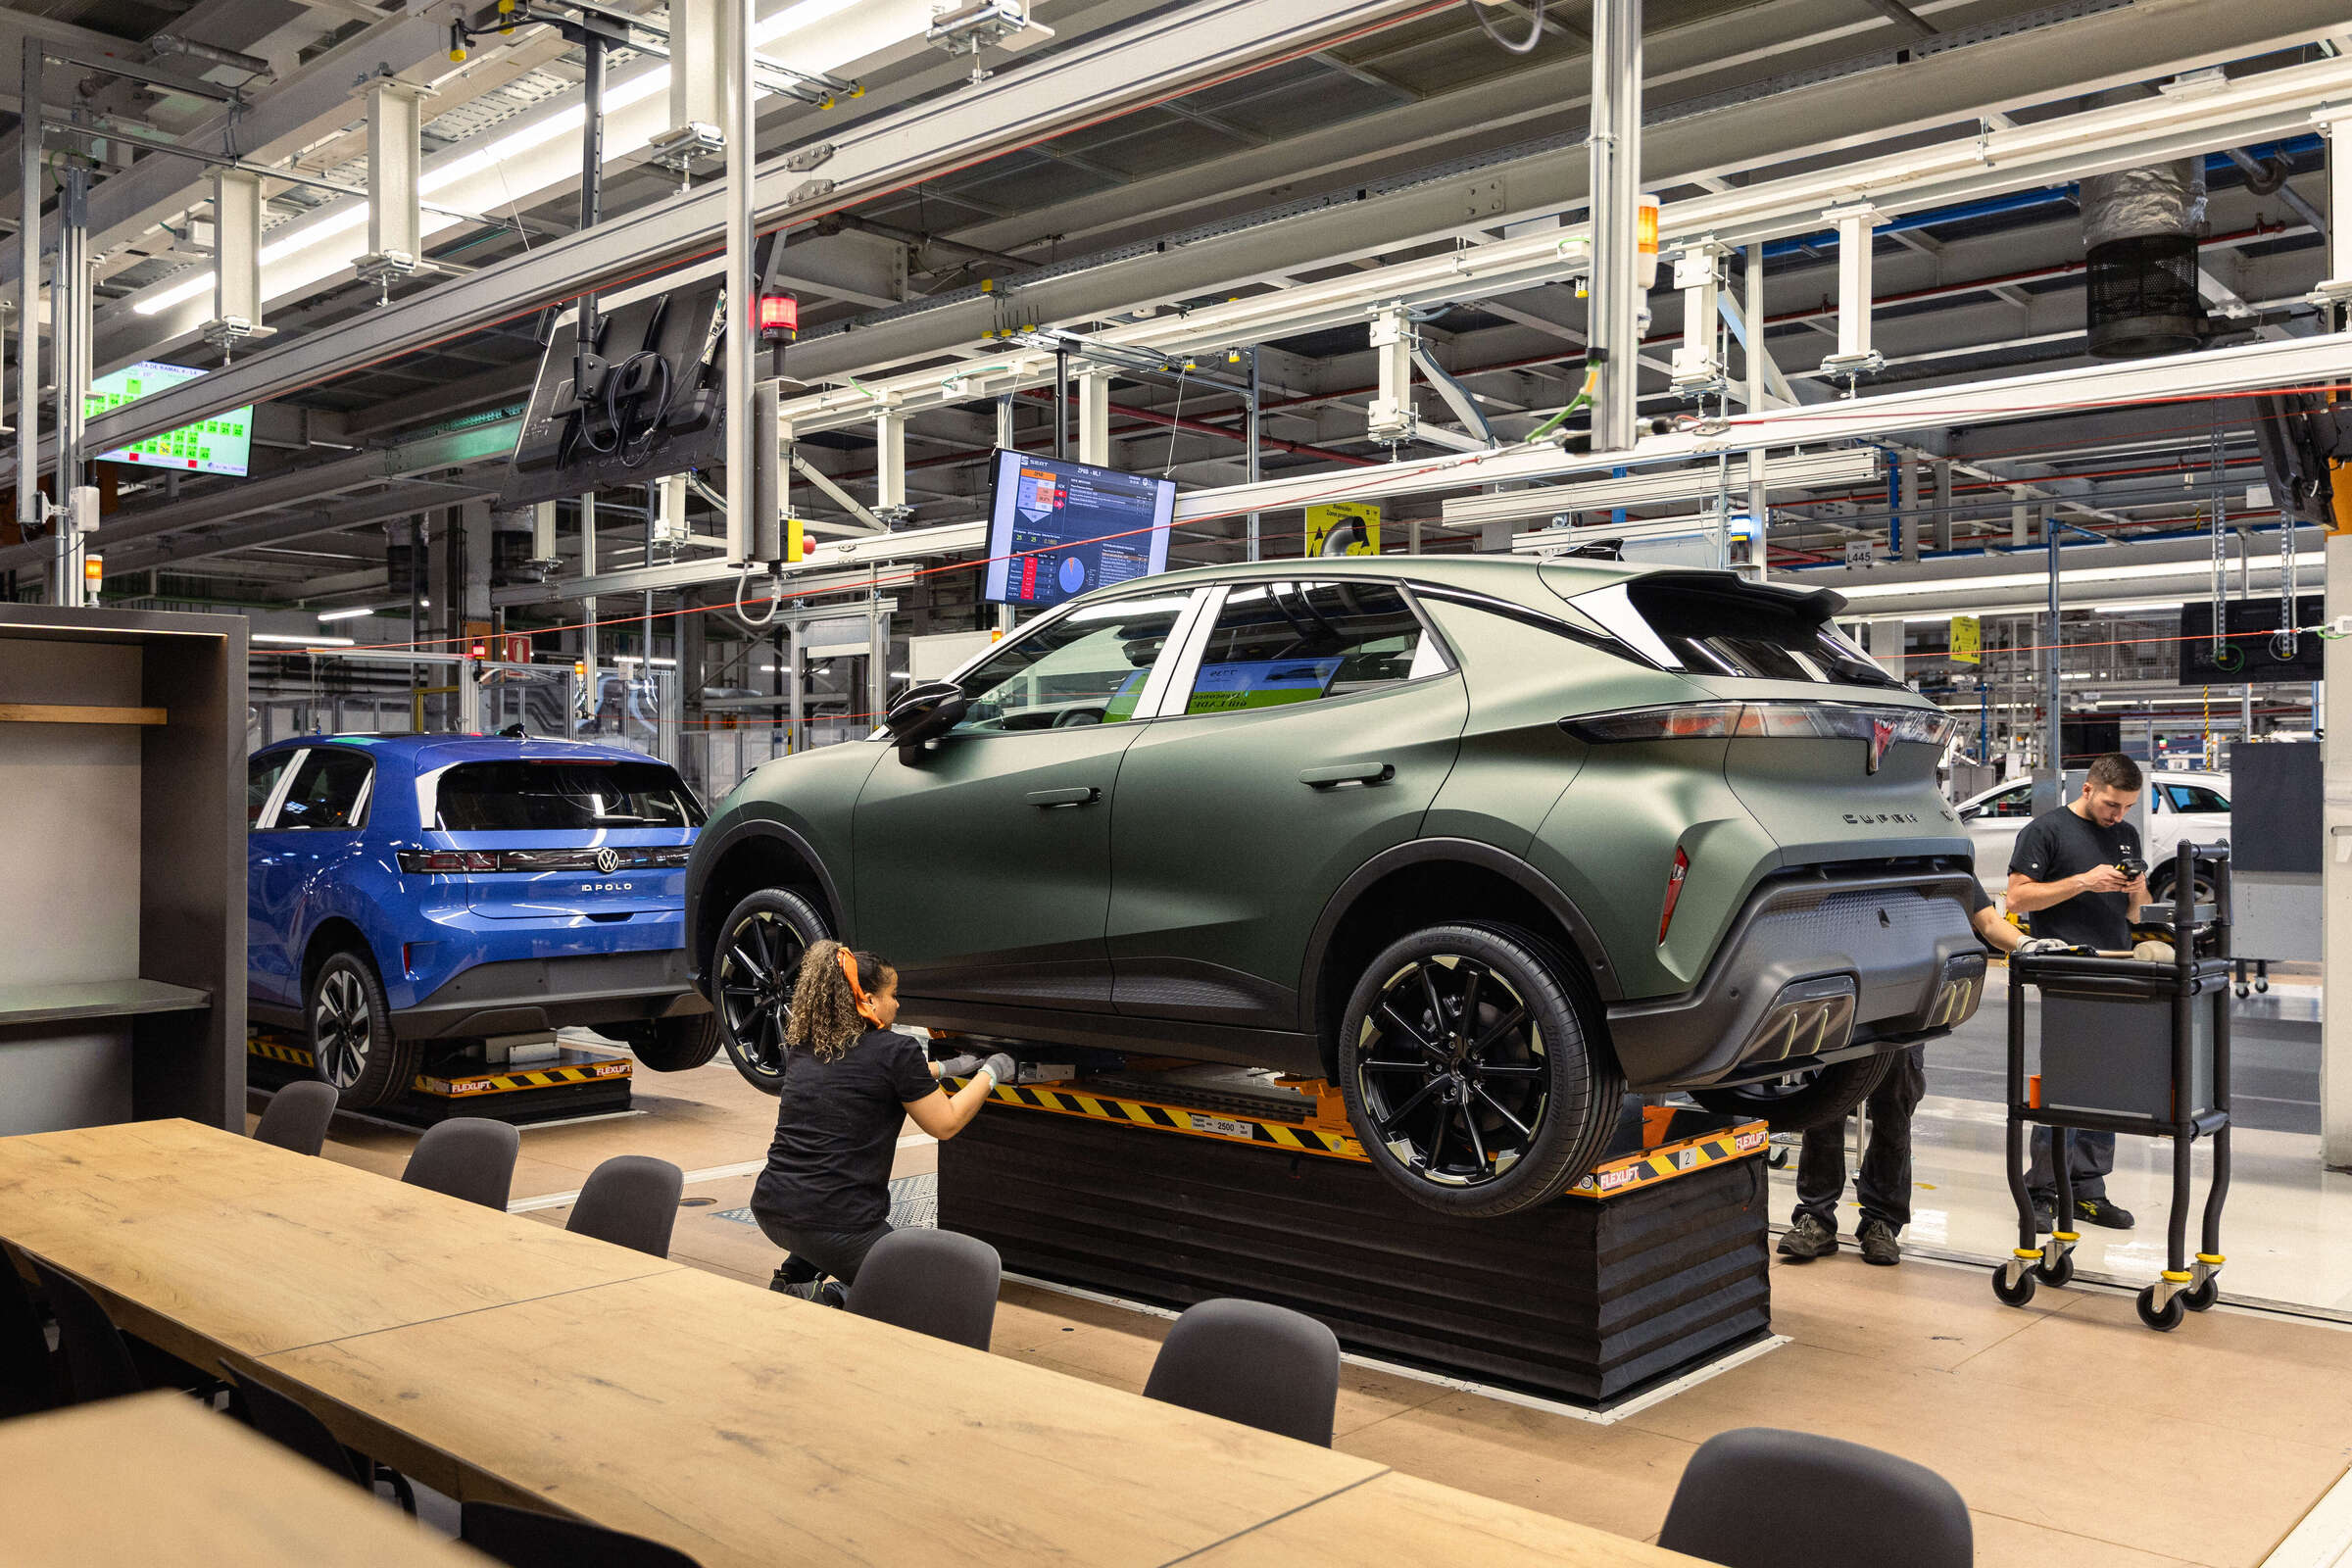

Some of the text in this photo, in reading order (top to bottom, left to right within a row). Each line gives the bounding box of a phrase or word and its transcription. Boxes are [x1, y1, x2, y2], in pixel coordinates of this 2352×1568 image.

[1847, 551, 1871, 563] L445
[1841, 813, 1919, 824] CUPRA
[595, 883, 632, 892] POLO
[596, 1064, 630, 1076] FLEXLIFT
[452, 1080, 491, 1094] FLEXLIFT
[1217, 1121, 1235, 1132] 2500
[1736, 1130, 1768, 1151] FLEXLIFT
[1685, 1152, 1690, 1164] 2
[1600, 1165, 1640, 1189] FLEXLIFT
